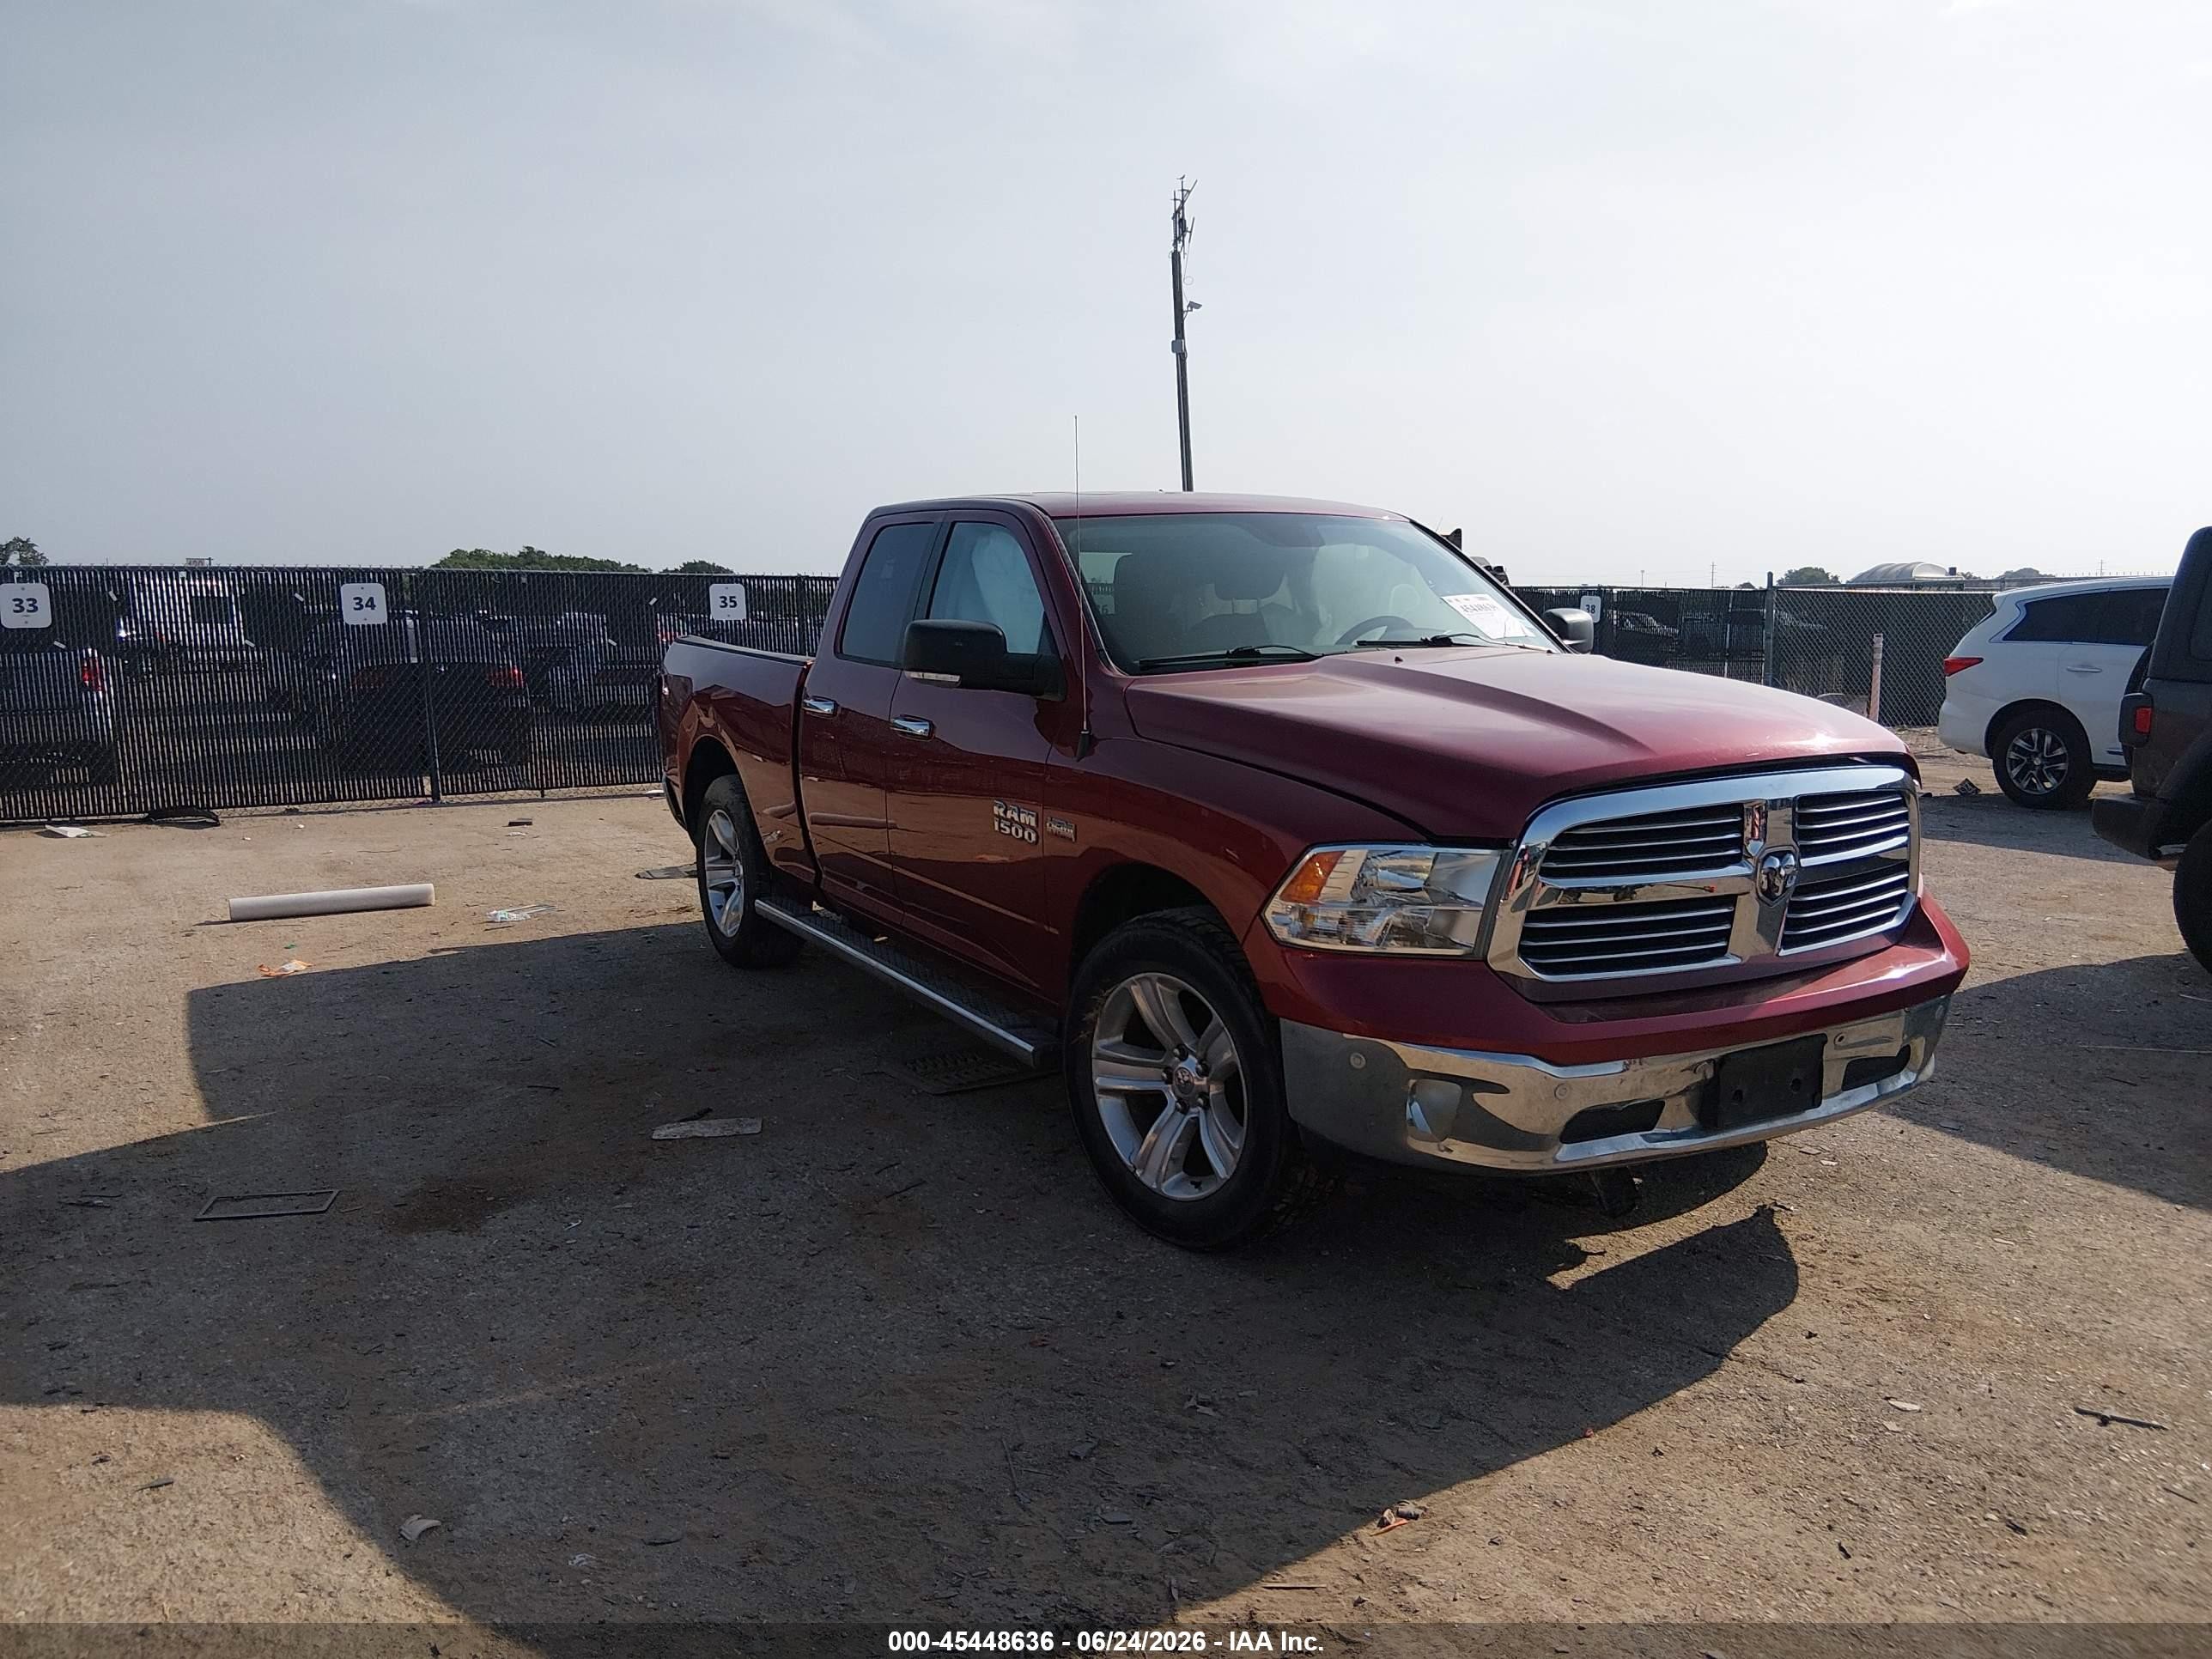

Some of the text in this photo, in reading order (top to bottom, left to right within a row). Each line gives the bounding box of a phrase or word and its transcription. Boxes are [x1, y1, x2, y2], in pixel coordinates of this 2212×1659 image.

[12, 598, 39, 614] 33
[353, 596, 377, 611] 34
[719, 595, 738, 609] 35
[1585, 604, 1595, 614] 38
[993, 799, 1038, 828] RAM
[994, 817, 1039, 844] 1500
